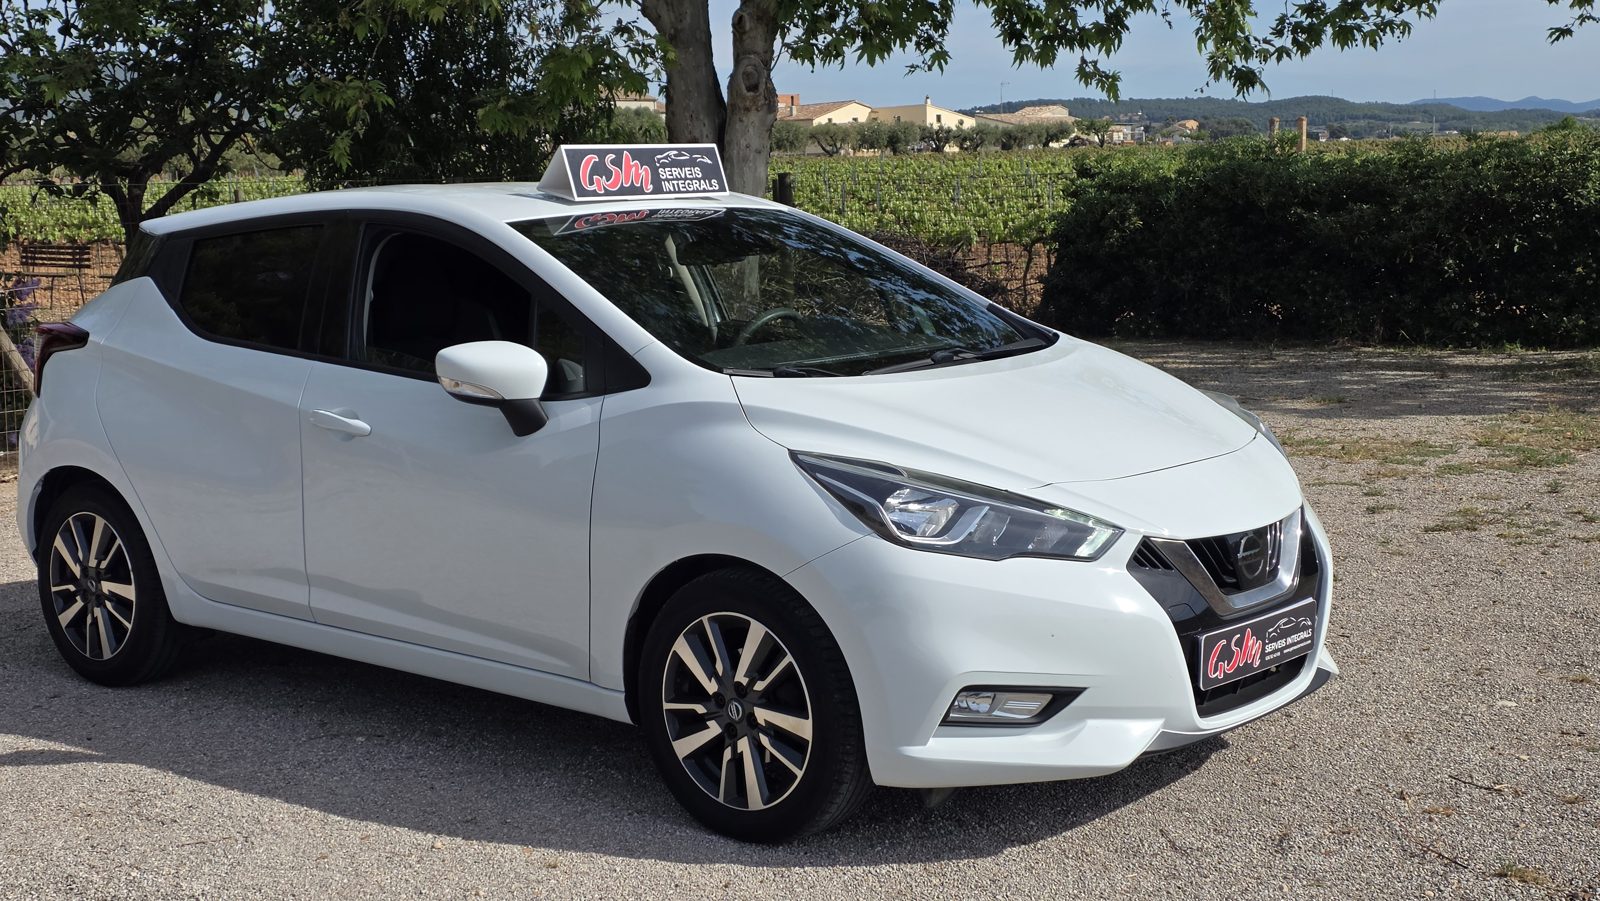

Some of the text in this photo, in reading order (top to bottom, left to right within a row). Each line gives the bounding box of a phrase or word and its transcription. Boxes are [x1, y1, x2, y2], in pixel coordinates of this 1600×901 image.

[659, 166, 702, 179] SERVEIS
[661, 179, 719, 192] INTEGRALS
[1264, 638, 1286, 653] SERVEIS
[1286, 628, 1313, 645] INTEGRALS
